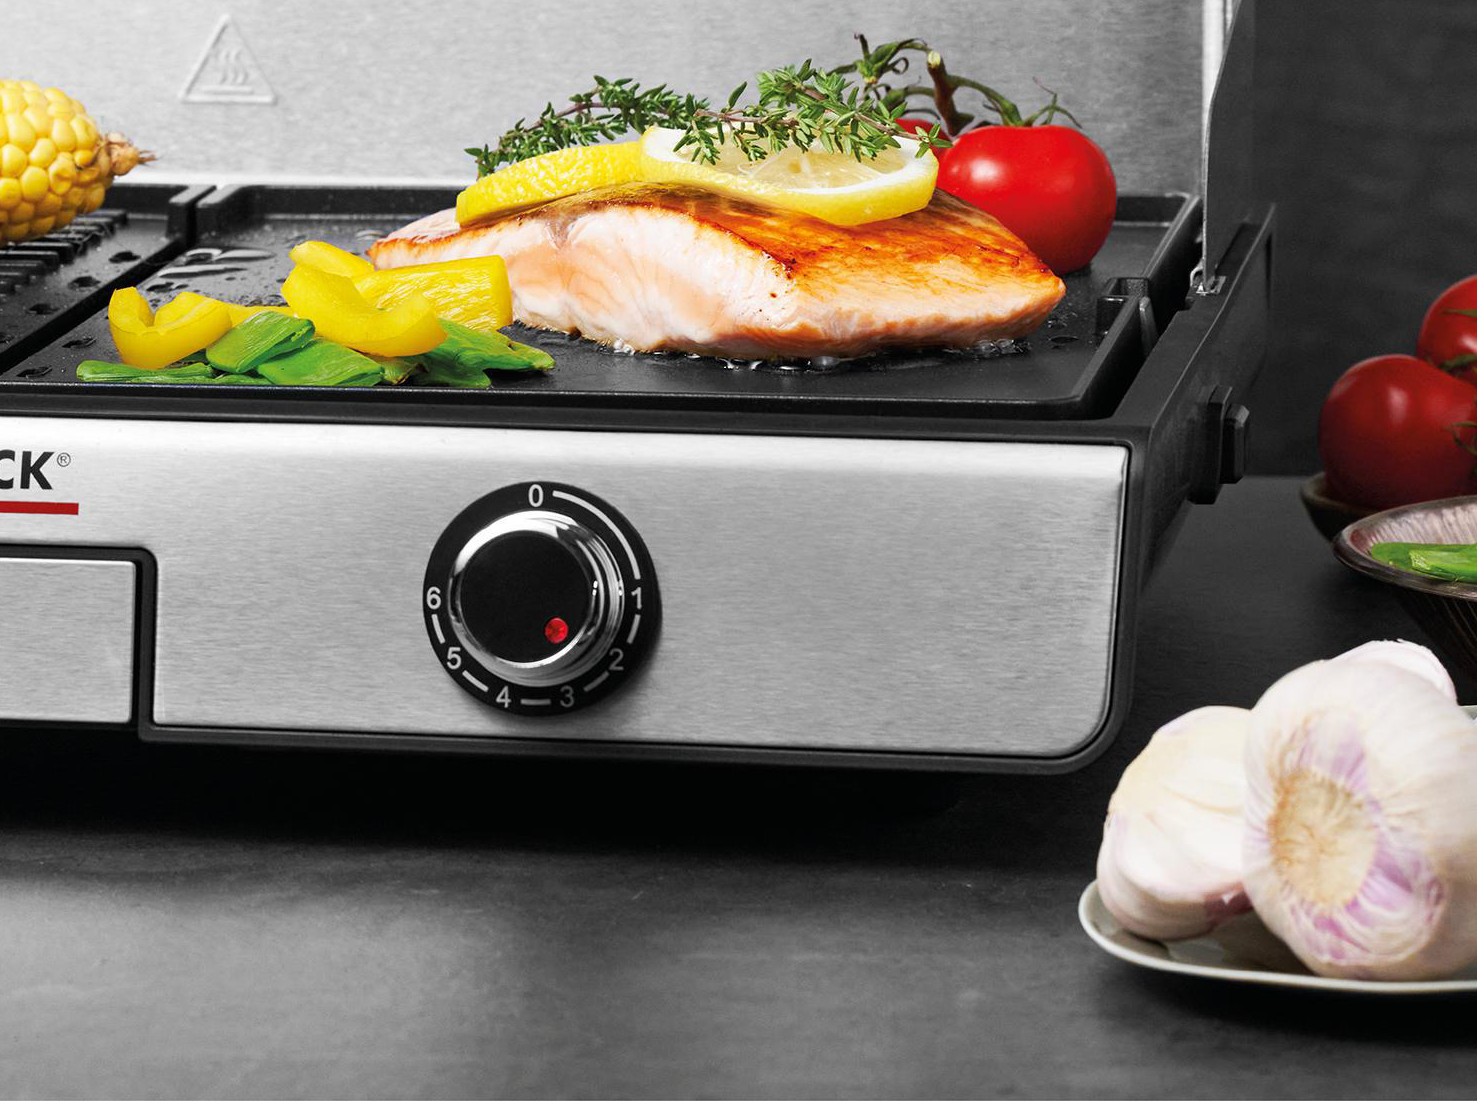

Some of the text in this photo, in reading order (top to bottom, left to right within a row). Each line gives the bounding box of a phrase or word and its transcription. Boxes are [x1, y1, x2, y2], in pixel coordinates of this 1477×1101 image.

[528, 484, 544, 507] 0
[426, 586, 441, 610] 6
[630, 586, 642, 610] 1
[446, 647, 462, 670] 5
[609, 648, 624, 671] 2
[496, 685, 511, 708] 4
[560, 685, 574, 708] 3
